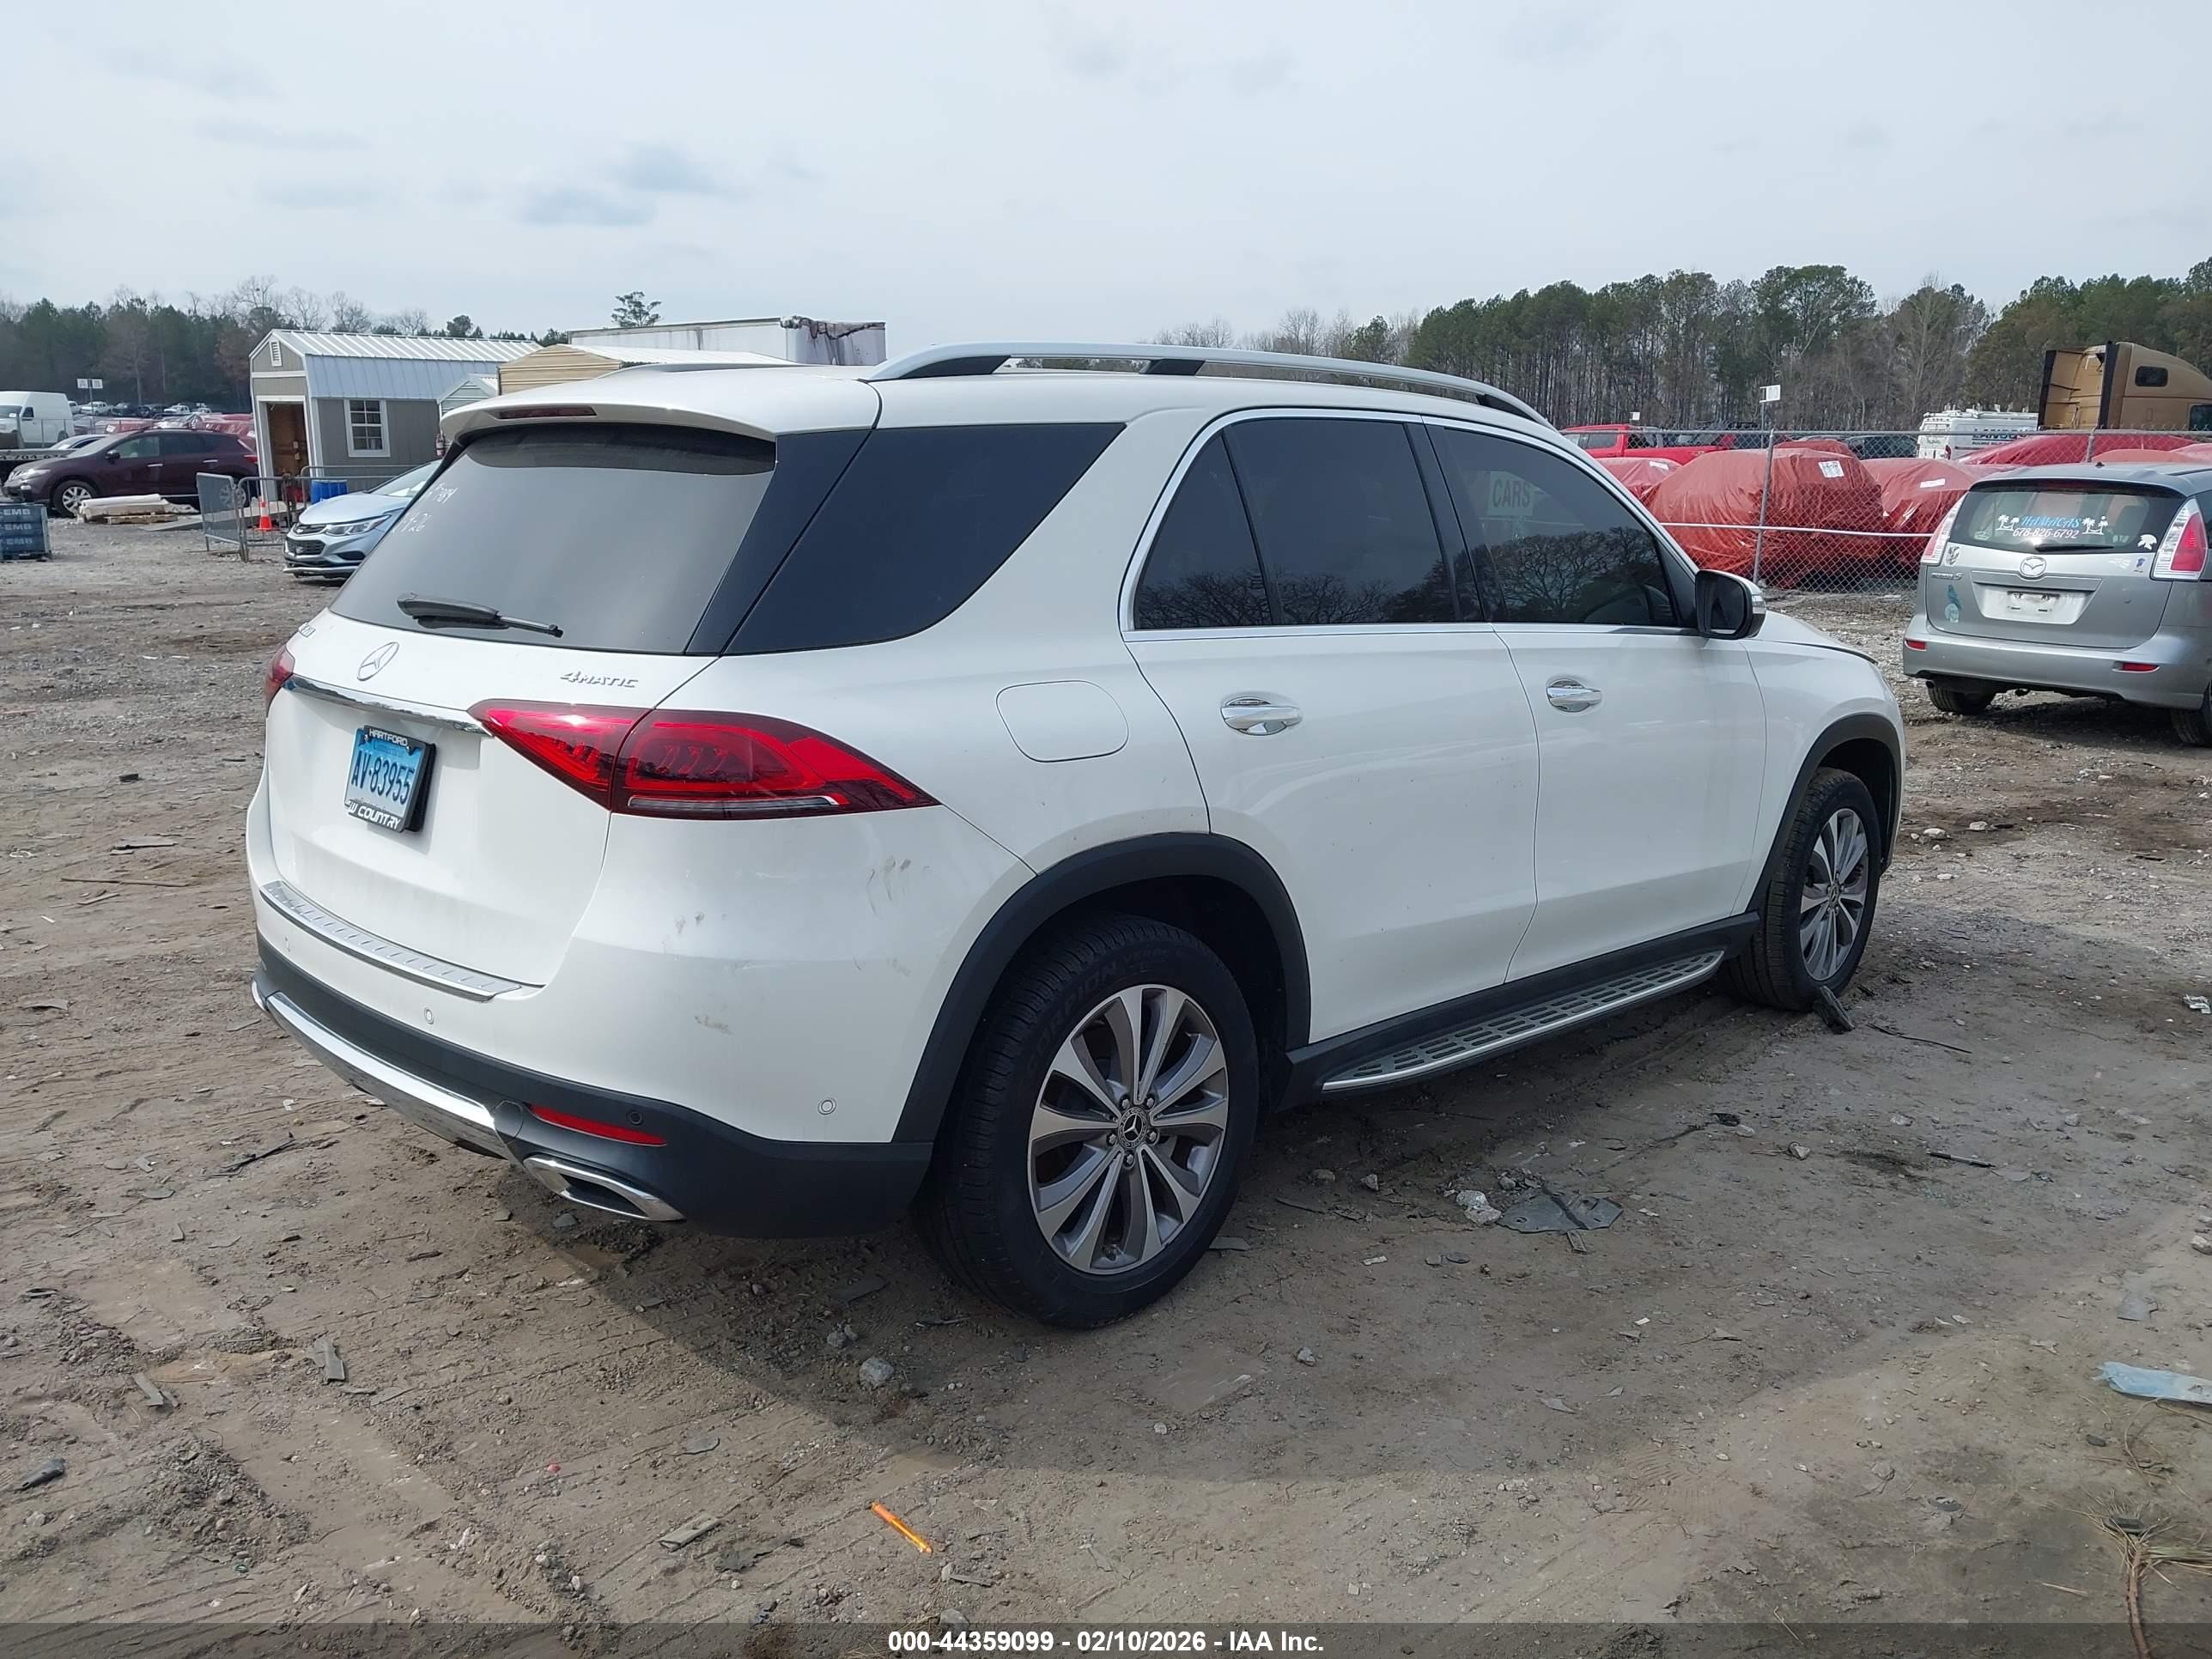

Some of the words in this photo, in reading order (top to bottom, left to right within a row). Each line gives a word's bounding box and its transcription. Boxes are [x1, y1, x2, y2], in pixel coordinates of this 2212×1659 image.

[1493, 479, 1530, 508] CARS
[2013, 527, 2080, 539] 678-826-6792
[560, 671, 639, 688] 4MATIC
[368, 728, 408, 746] HARTFORD
[357, 806, 401, 830] COUNTRY
